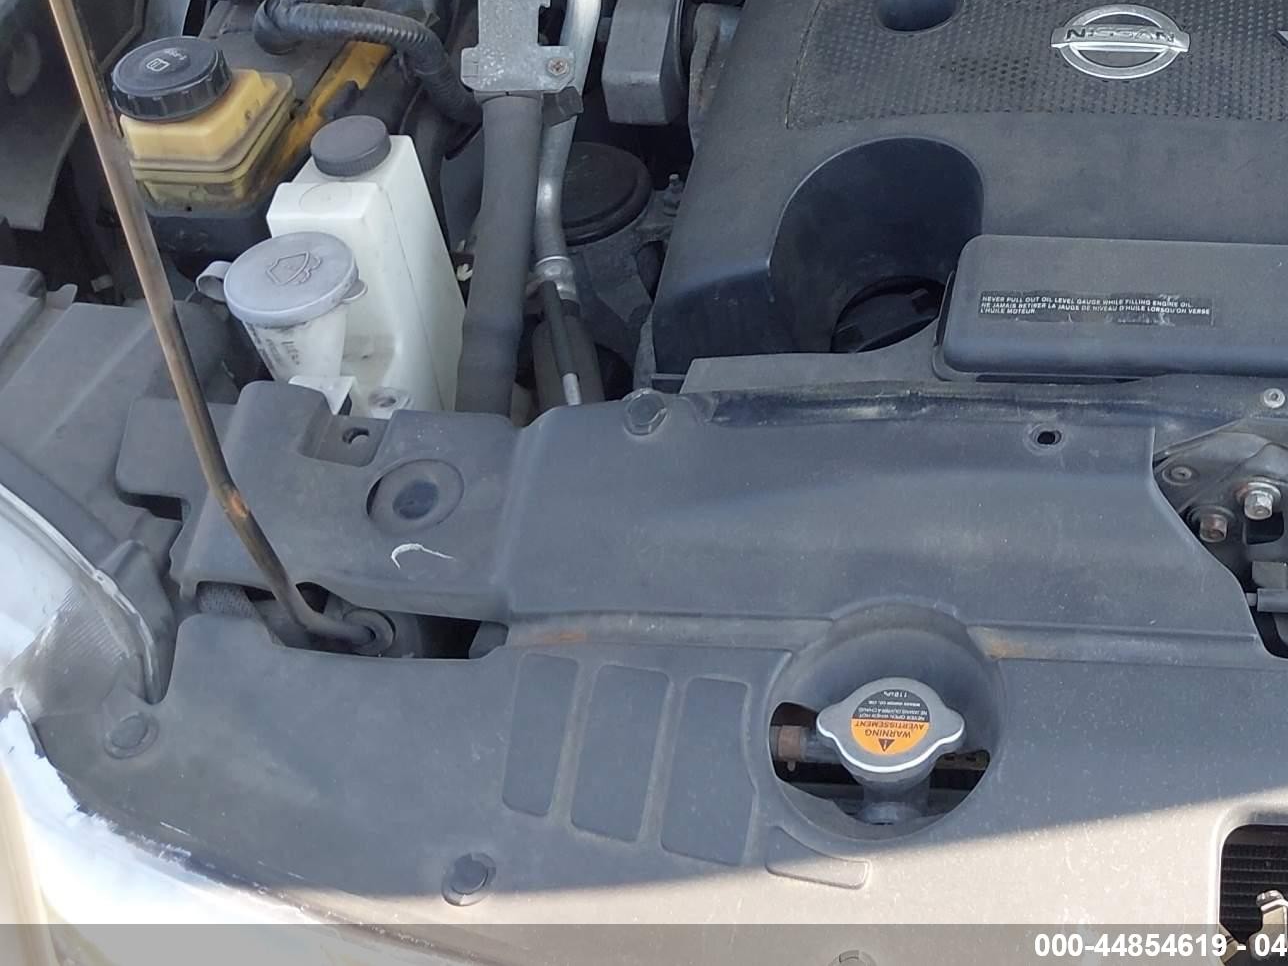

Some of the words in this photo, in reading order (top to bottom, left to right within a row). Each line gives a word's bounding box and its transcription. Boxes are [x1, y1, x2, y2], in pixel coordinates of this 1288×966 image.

[1065, 27, 1176, 43] NISSAN
[1102, 298, 1123, 306] WHILE
[1188, 307, 1210, 315] VERSE
[855, 720, 925, 730] AVERTISSEMENT
[864, 728, 912, 739] WARNING
